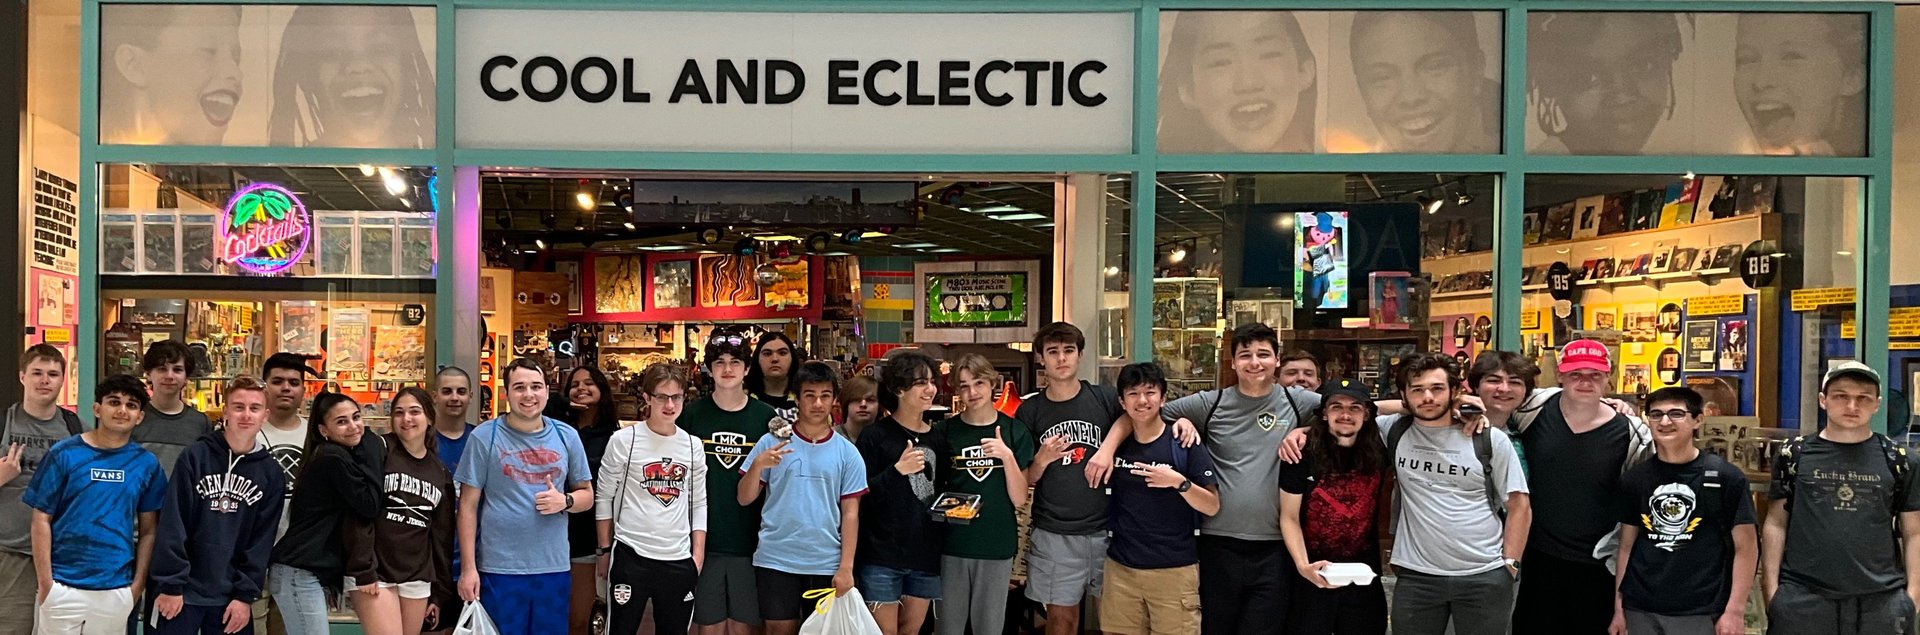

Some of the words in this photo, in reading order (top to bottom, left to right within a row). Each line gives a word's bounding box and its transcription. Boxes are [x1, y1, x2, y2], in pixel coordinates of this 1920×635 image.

[480, 55, 650, 103] COOL
[668, 59, 806, 105] AND
[827, 59, 1108, 107] ECLECTIC
[225, 205, 304, 263] Cocktails
[719, 434, 738, 446] MK
[714, 445, 742, 455] CHOIR
[965, 458, 994, 467] CHOIR
[1397, 456, 1472, 477] HURLEY
[94, 470, 122, 481] VANS
[383, 472, 400, 494] ONG
[399, 472, 421, 496] BEACH
[386, 511, 406, 523] NEW
[1647, 533, 1659, 541] TO
[1659, 534, 1676, 542] THE
